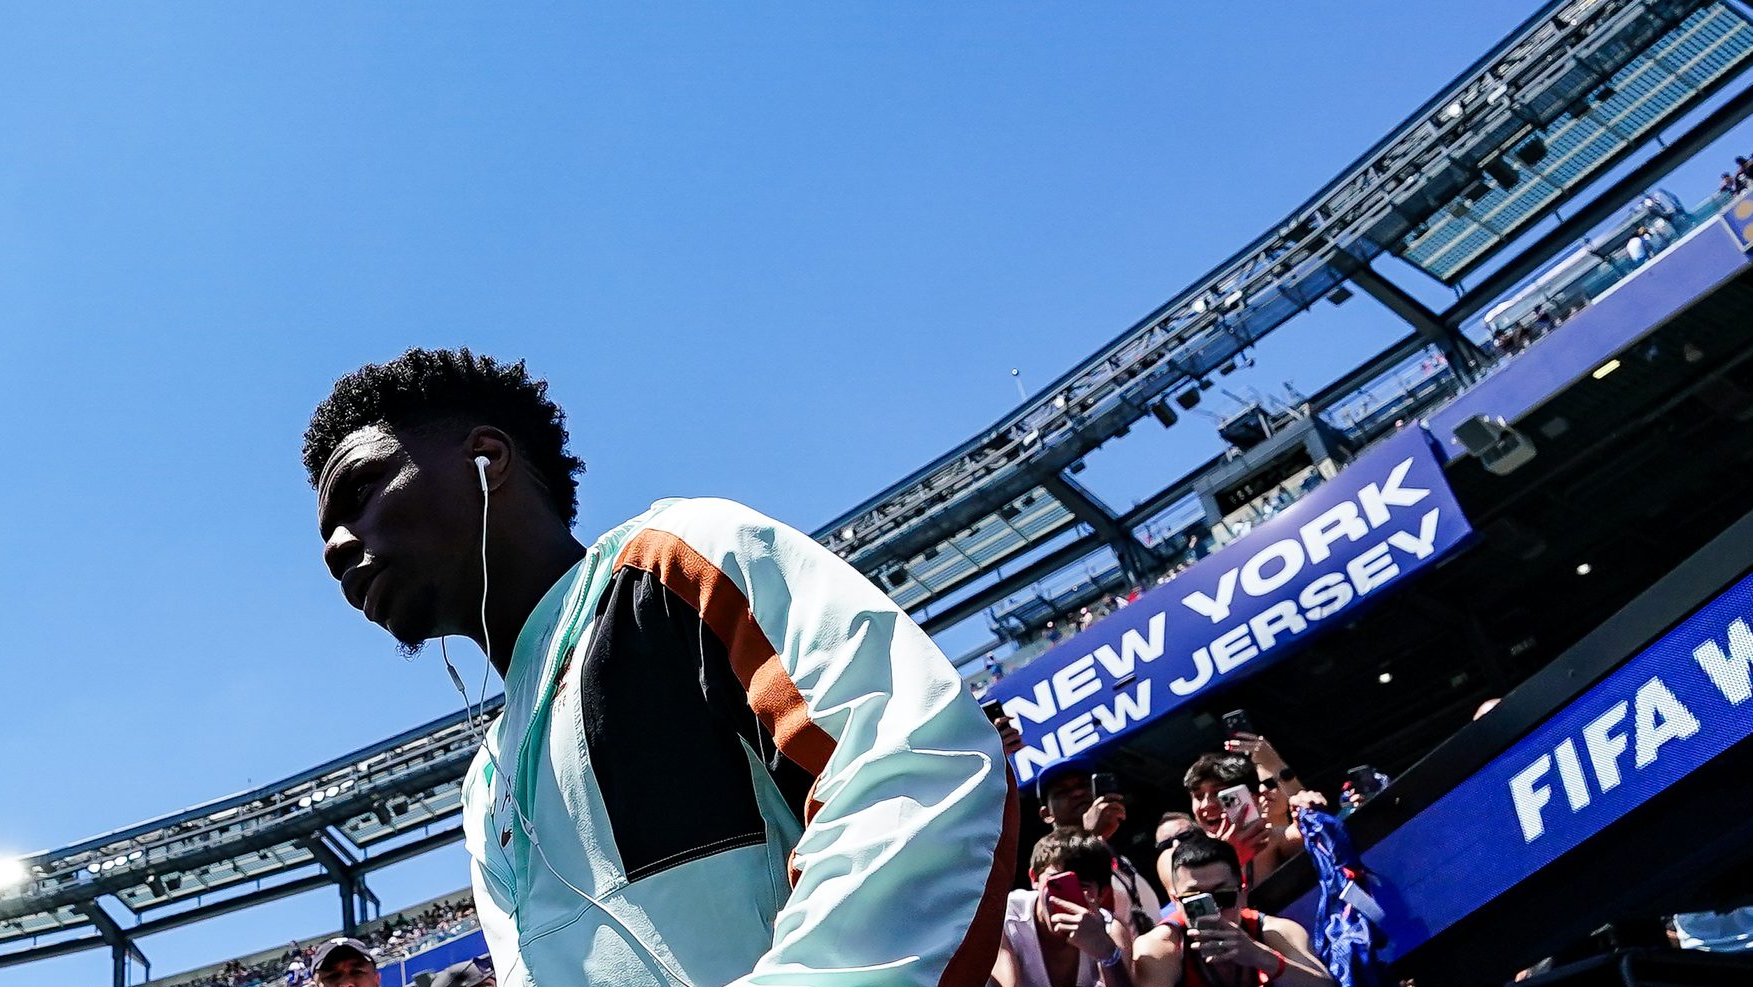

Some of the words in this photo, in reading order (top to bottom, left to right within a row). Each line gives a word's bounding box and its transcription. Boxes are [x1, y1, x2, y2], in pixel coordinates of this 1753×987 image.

[1002, 612, 1167, 735] NEW
[1182, 457, 1430, 623] YORK
[1015, 679, 1151, 782] NEW
[1169, 508, 1440, 696] JERSEY
[1509, 675, 1701, 843] FIFA
